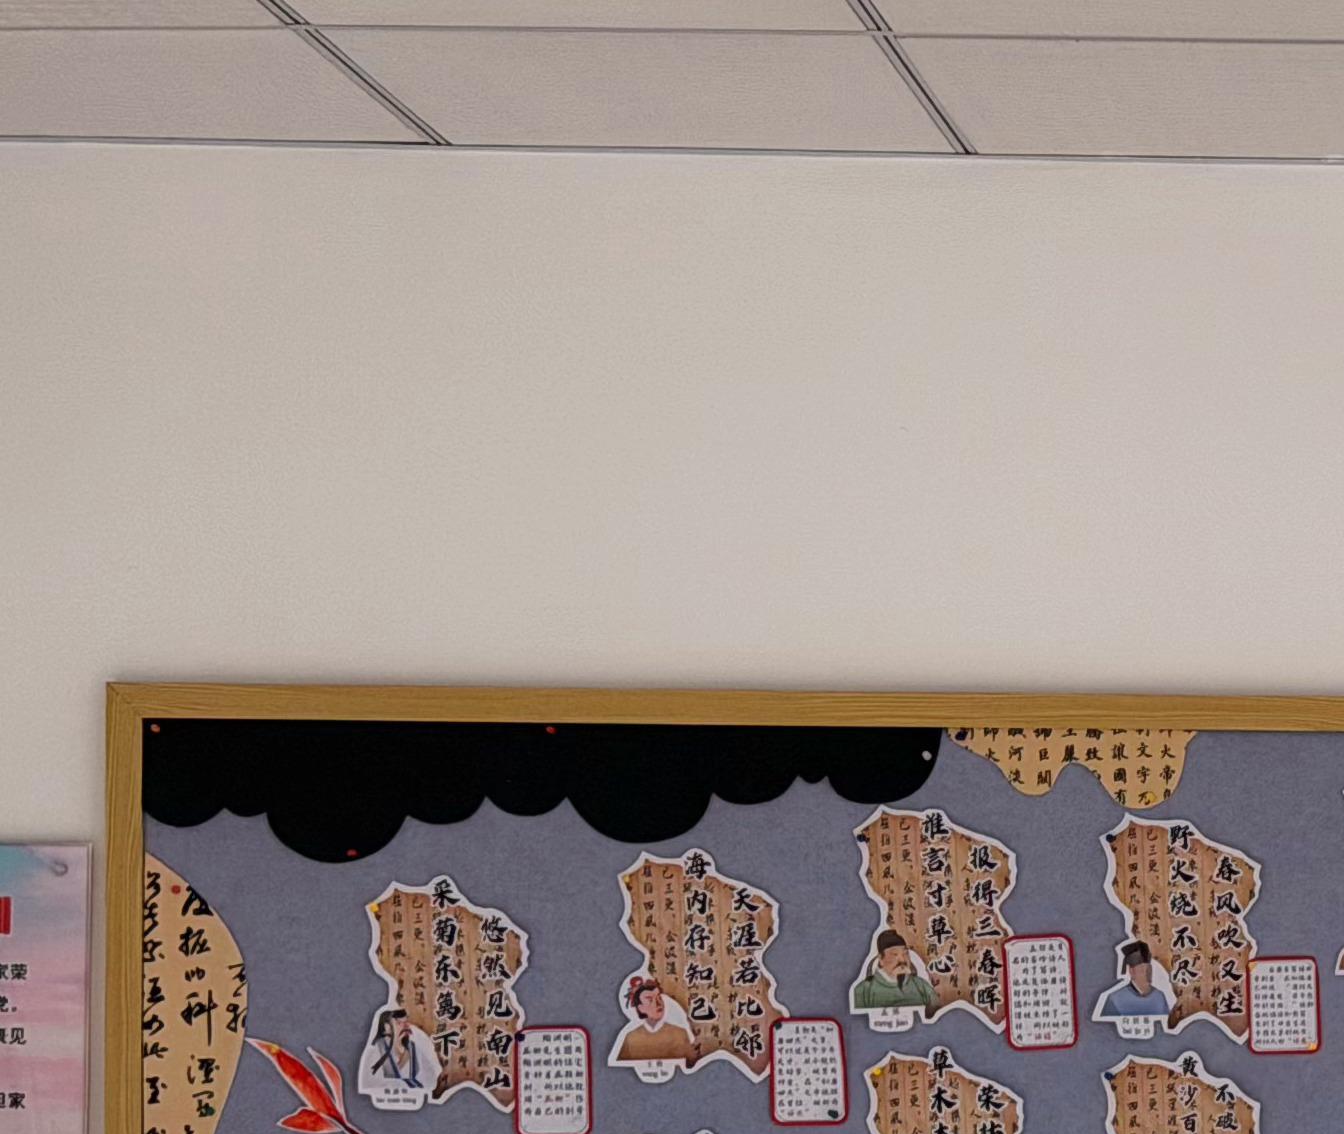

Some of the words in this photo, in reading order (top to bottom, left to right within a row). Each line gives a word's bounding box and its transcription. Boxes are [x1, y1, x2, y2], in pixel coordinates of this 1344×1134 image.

[685, 852, 715, 1020] 海内存知己
[734, 888, 763, 1056] 天涯若比邻
[923, 814, 954, 973] 谁言寸草心
[969, 847, 1002, 1010] 报得三春晖
[1170, 825, 1199, 984] 野火烧不尽
[1216, 857, 1244, 1015] 春风吹又生
[481, 915, 513, 1089] 悠然见南山
